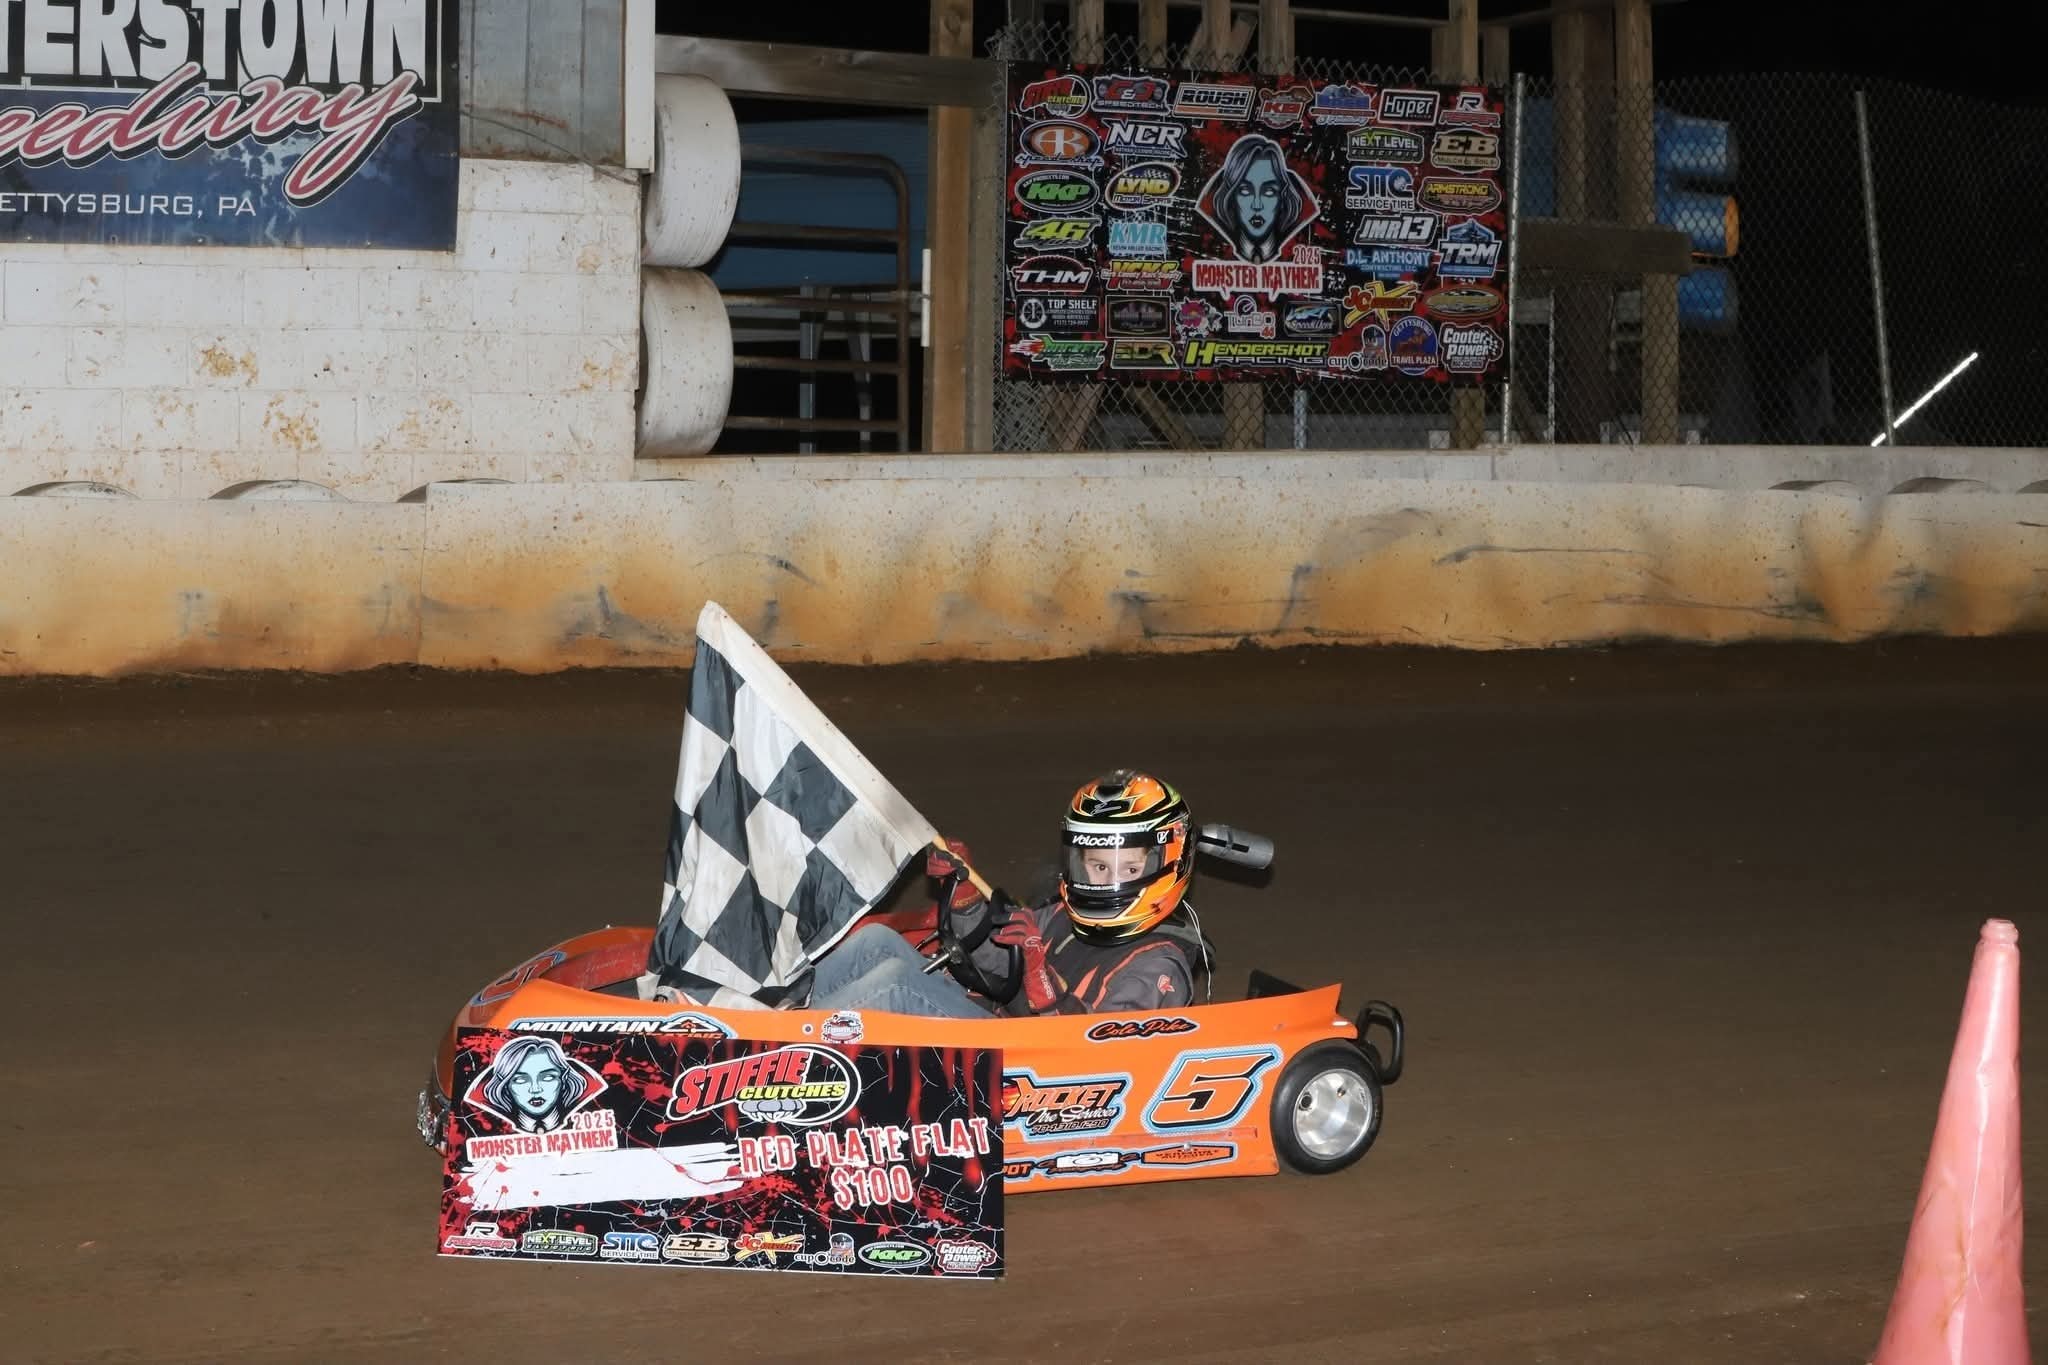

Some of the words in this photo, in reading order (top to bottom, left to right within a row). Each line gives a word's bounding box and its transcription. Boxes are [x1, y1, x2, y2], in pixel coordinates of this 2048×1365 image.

[1181, 89, 1249, 107] ROUSH
[1384, 96, 1433, 119] Hyper
[1107, 123, 1185, 152] NCR
[1352, 131, 1381, 147] NEXT
[1384, 138, 1418, 149] LEVEL
[1434, 136, 1496, 155] EB
[1026, 183, 1090, 201] KKP
[1115, 178, 1171, 196] LYND
[1425, 182, 1488, 196] ARMSTRONG
[217, 196, 257, 216] PA
[1346, 198, 1389, 209] SERVICE
[1391, 199, 1414, 210] TIRE
[1112, 222, 1166, 243] KMR
[1294, 247, 1320, 264] 2025
[1372, 251, 1431, 267] ANTHONY
[1441, 243, 1498, 265] TRM
[1015, 270, 1091, 284] THM
[1195, 263, 1257, 289] MONSTER
[1261, 265, 1320, 290] MAYHEM
[1047, 299, 1067, 309] TOP
[1068, 300, 1098, 310] SHELF
[1392, 318, 1433, 337] GETTYSBURG
[1443, 327, 1486, 345] Cooter
[1186, 341, 1329, 365] HENDERSHOT
[1213, 356, 1325, 365] RACING
[1392, 356, 1414, 365] TRAVEL
[1415, 356, 1437, 365] PLAZA
[515, 1021, 661, 1034] MOUNTAIN
[675, 1051, 810, 1114] STIFFIE
[738, 1083, 847, 1100] CLUTCHES
[1150, 1052, 1275, 1124] 5
[1004, 1077, 1122, 1118] ROCKET
[572, 1111, 614, 1130] 2025
[470, 1136, 543, 1159] MONSTER
[546, 1129, 614, 1153] MAYHEM
[740, 1136, 797, 1174] RED
[807, 1126, 903, 1168] PLATE
[912, 1117, 990, 1157] FLAT
[832, 1165, 913, 1209] $100
[527, 1232, 556, 1244] NEXT
[558, 1235, 593, 1246] LEVEL
[664, 1236, 727, 1252] EB
[601, 1250, 637, 1258] SERVICE
[639, 1251, 658, 1259] TIRE
[868, 1249, 923, 1261] KKP
[941, 1243, 979, 1255] Cooter
[795, 1254, 814, 1265] cup
